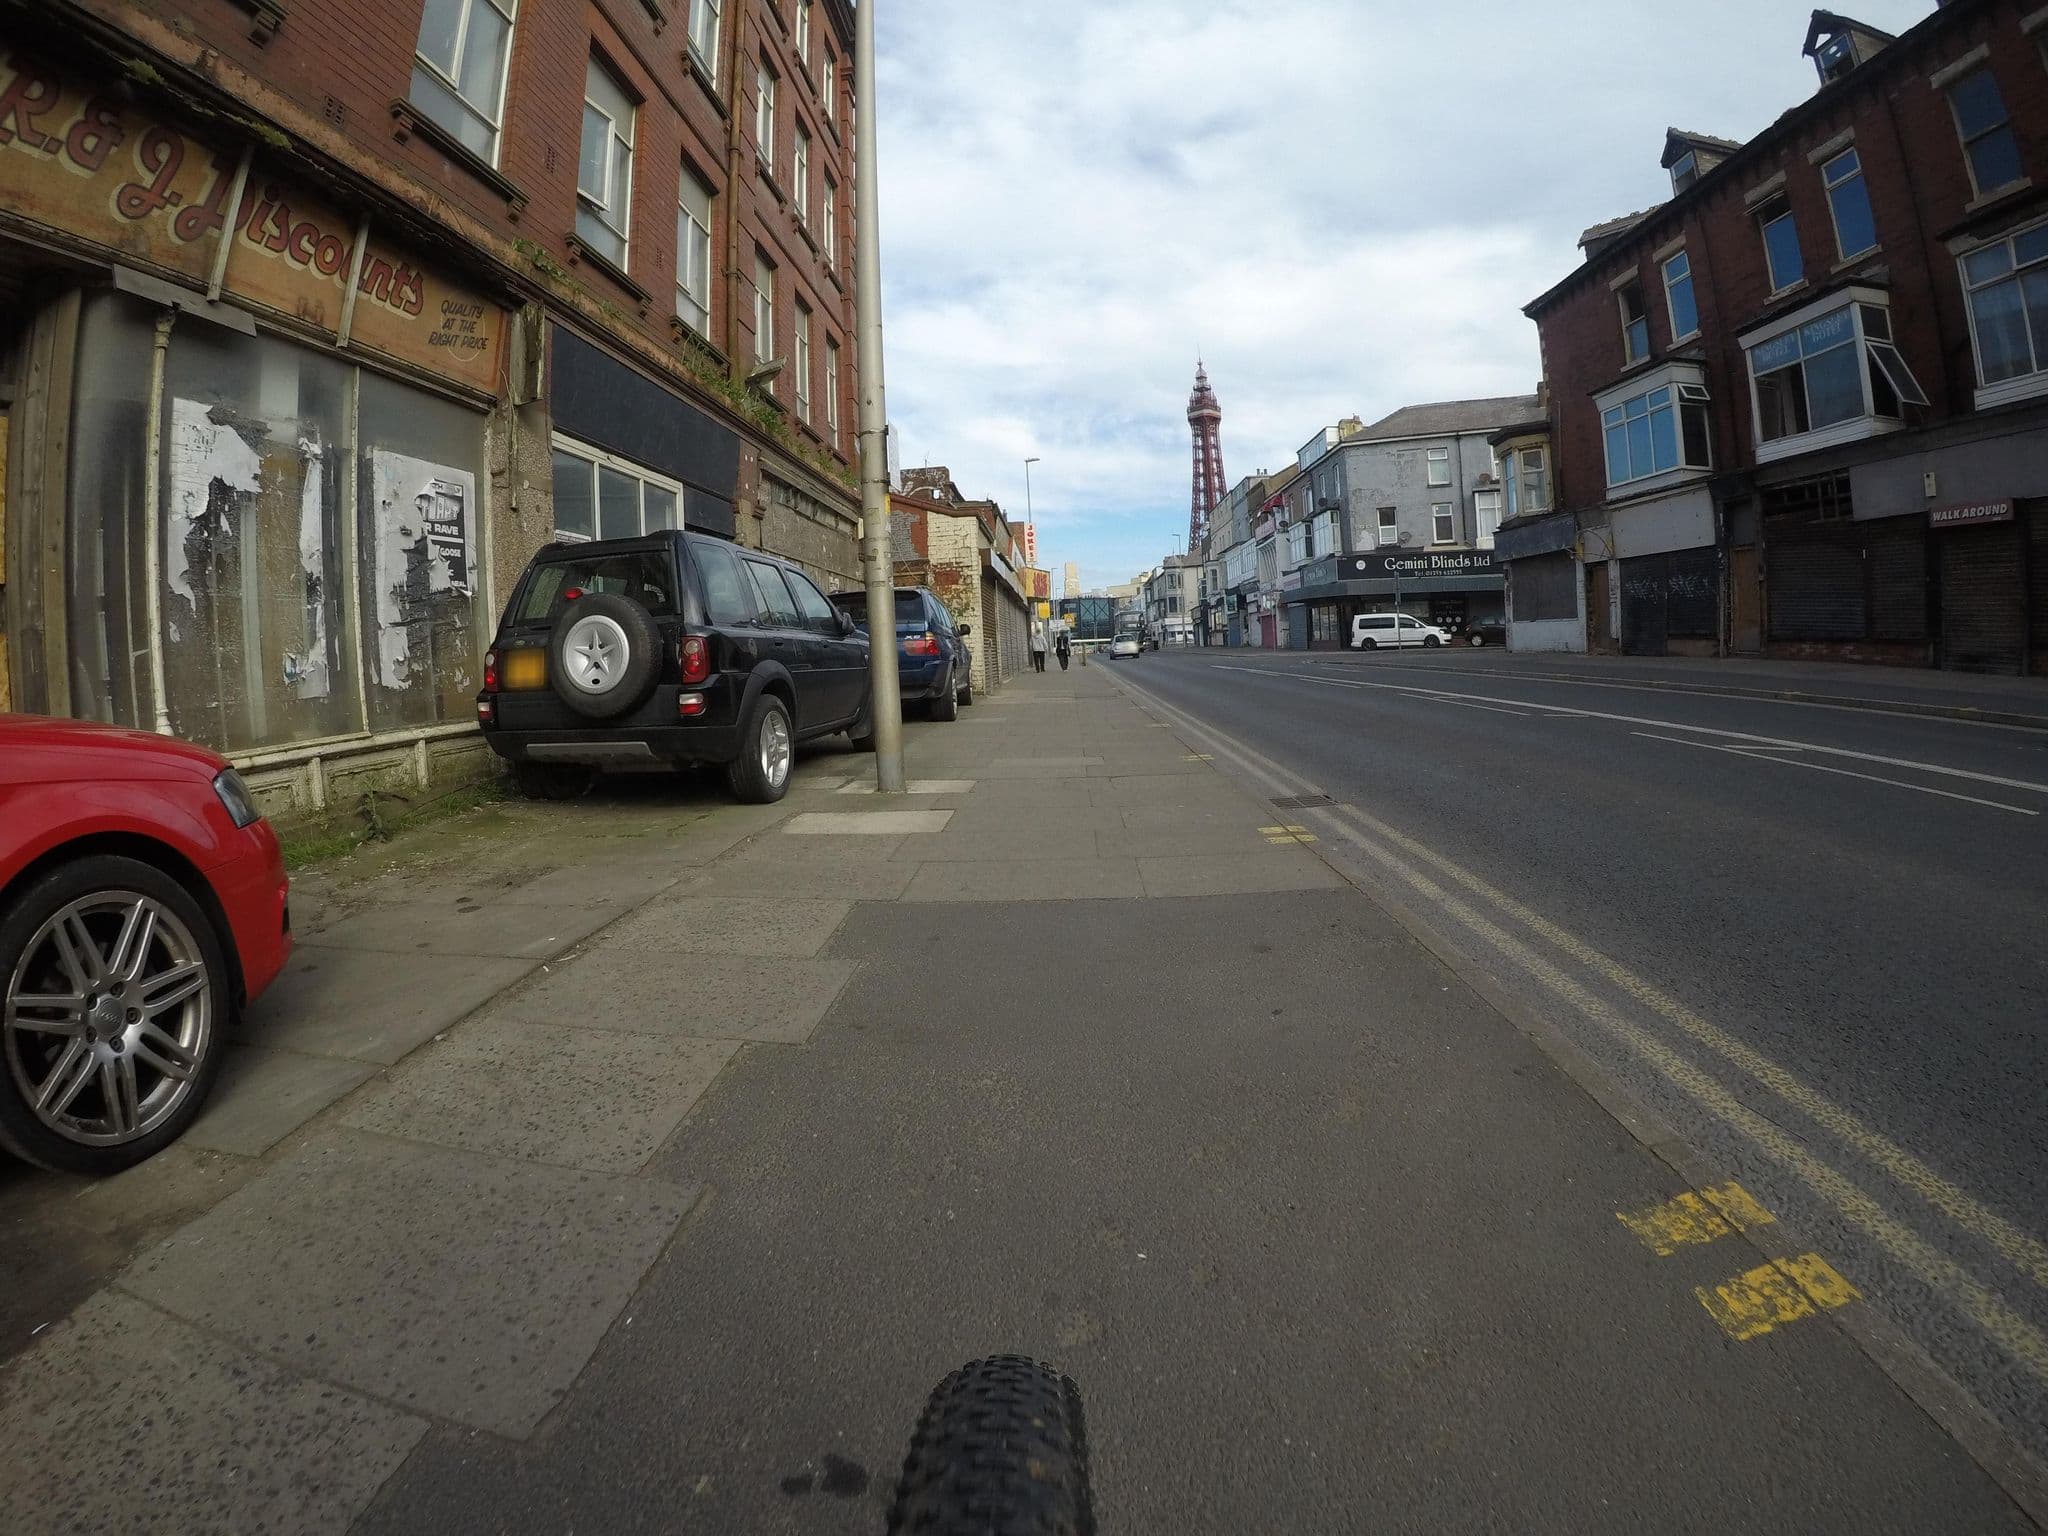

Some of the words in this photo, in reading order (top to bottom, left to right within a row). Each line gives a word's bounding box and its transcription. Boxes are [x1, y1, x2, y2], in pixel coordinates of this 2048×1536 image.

[441, 299, 485, 319] QUALITY
[442, 318, 456, 331] AT
[459, 319, 477, 333] THE
[428, 331, 460, 348] RIGHT
[460, 335, 489, 350] PRICE
[1933, 509, 1960, 521] WALK
[1962, 503, 2008, 518] AROUND
[434, 523, 459, 535] RAVE
[1384, 556, 1428, 570] Gemini
[1431, 555, 1470, 568] Blinds
[1474, 555, 1490, 567] Ltd
